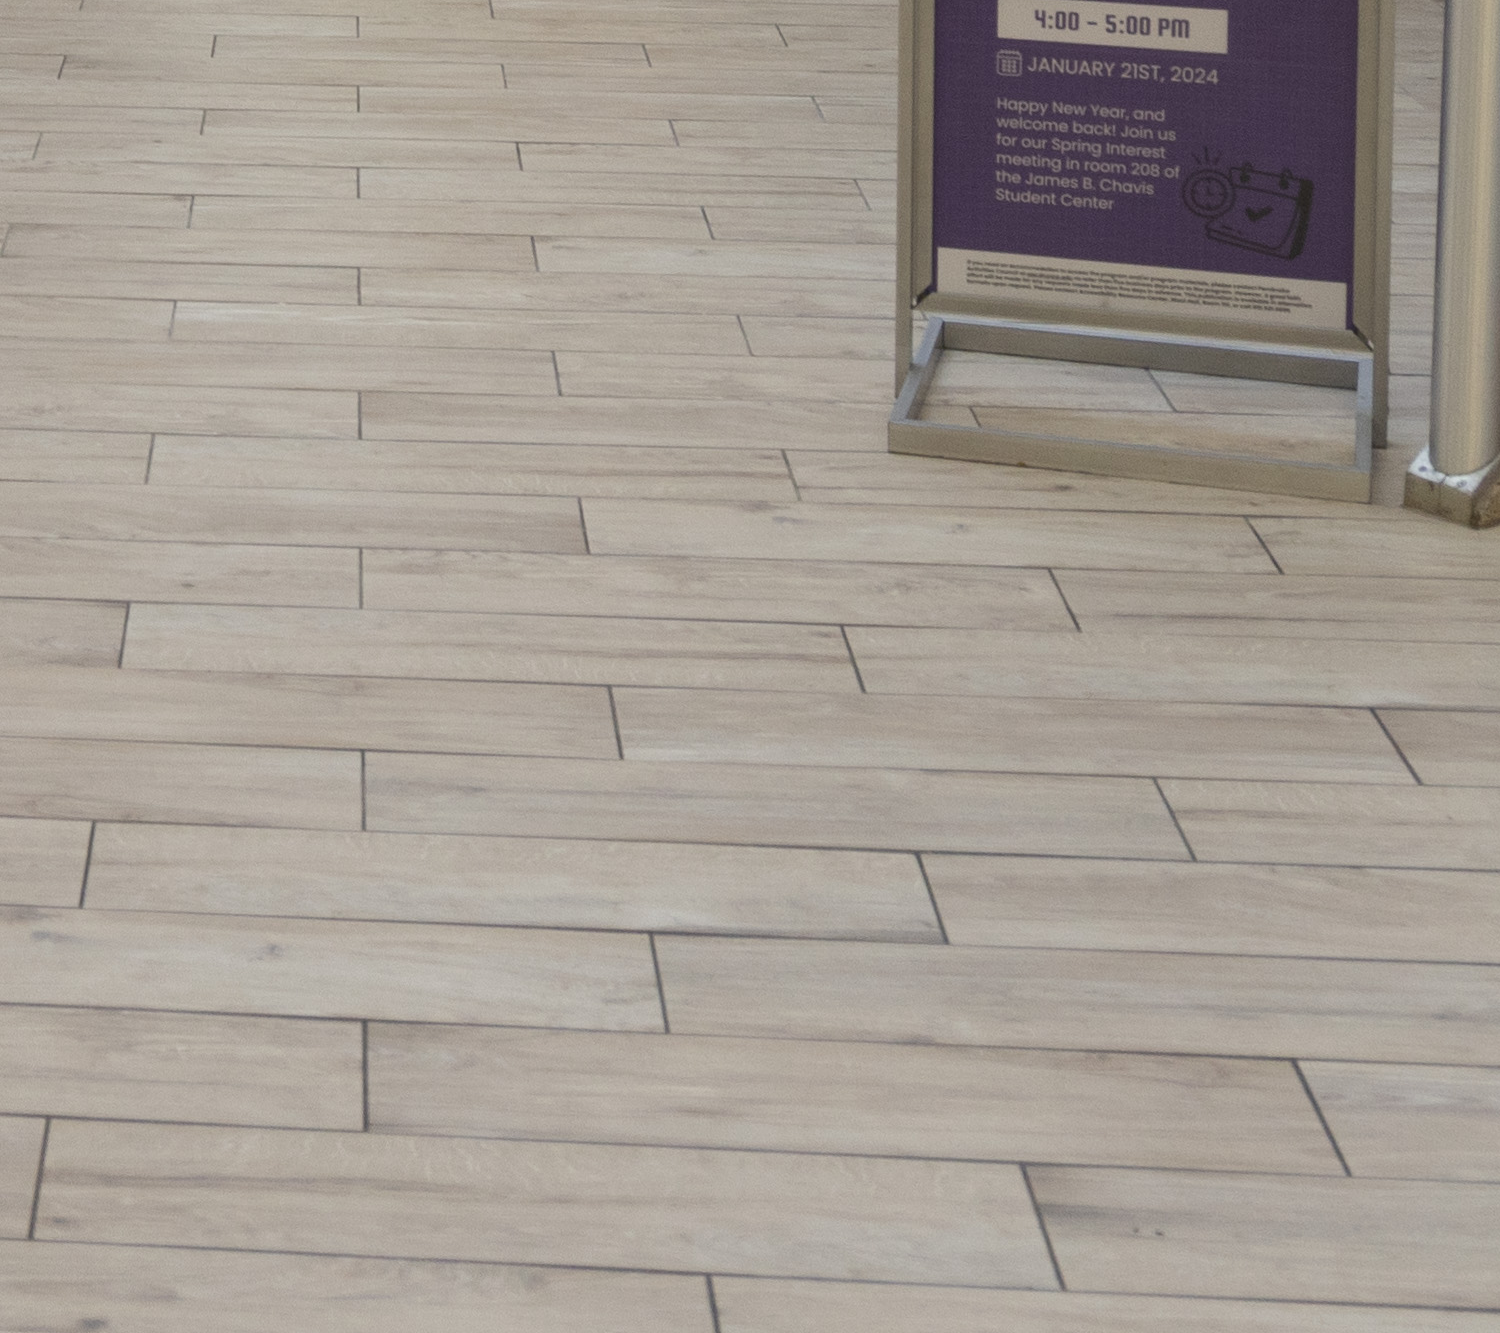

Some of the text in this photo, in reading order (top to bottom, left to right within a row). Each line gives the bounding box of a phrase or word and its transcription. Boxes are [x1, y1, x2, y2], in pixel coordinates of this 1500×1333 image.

[1034, 9, 1080, 31] 4:00
[1105, 14, 1151, 36] 5:00
[1158, 18, 1191, 39] PM
[1027, 55, 1220, 86] JANUARY 21ST, 2024
[996, 96, 1165, 123] Happy New Year, and
[995, 116, 1177, 142] welcome back! Join us
[995, 133, 1166, 160] for our Spring Interest
[995, 152, 1180, 180] meeting in room 208 of
[995, 169, 1155, 196] the James B. Chavis
[995, 187, 1115, 210] Student Center
